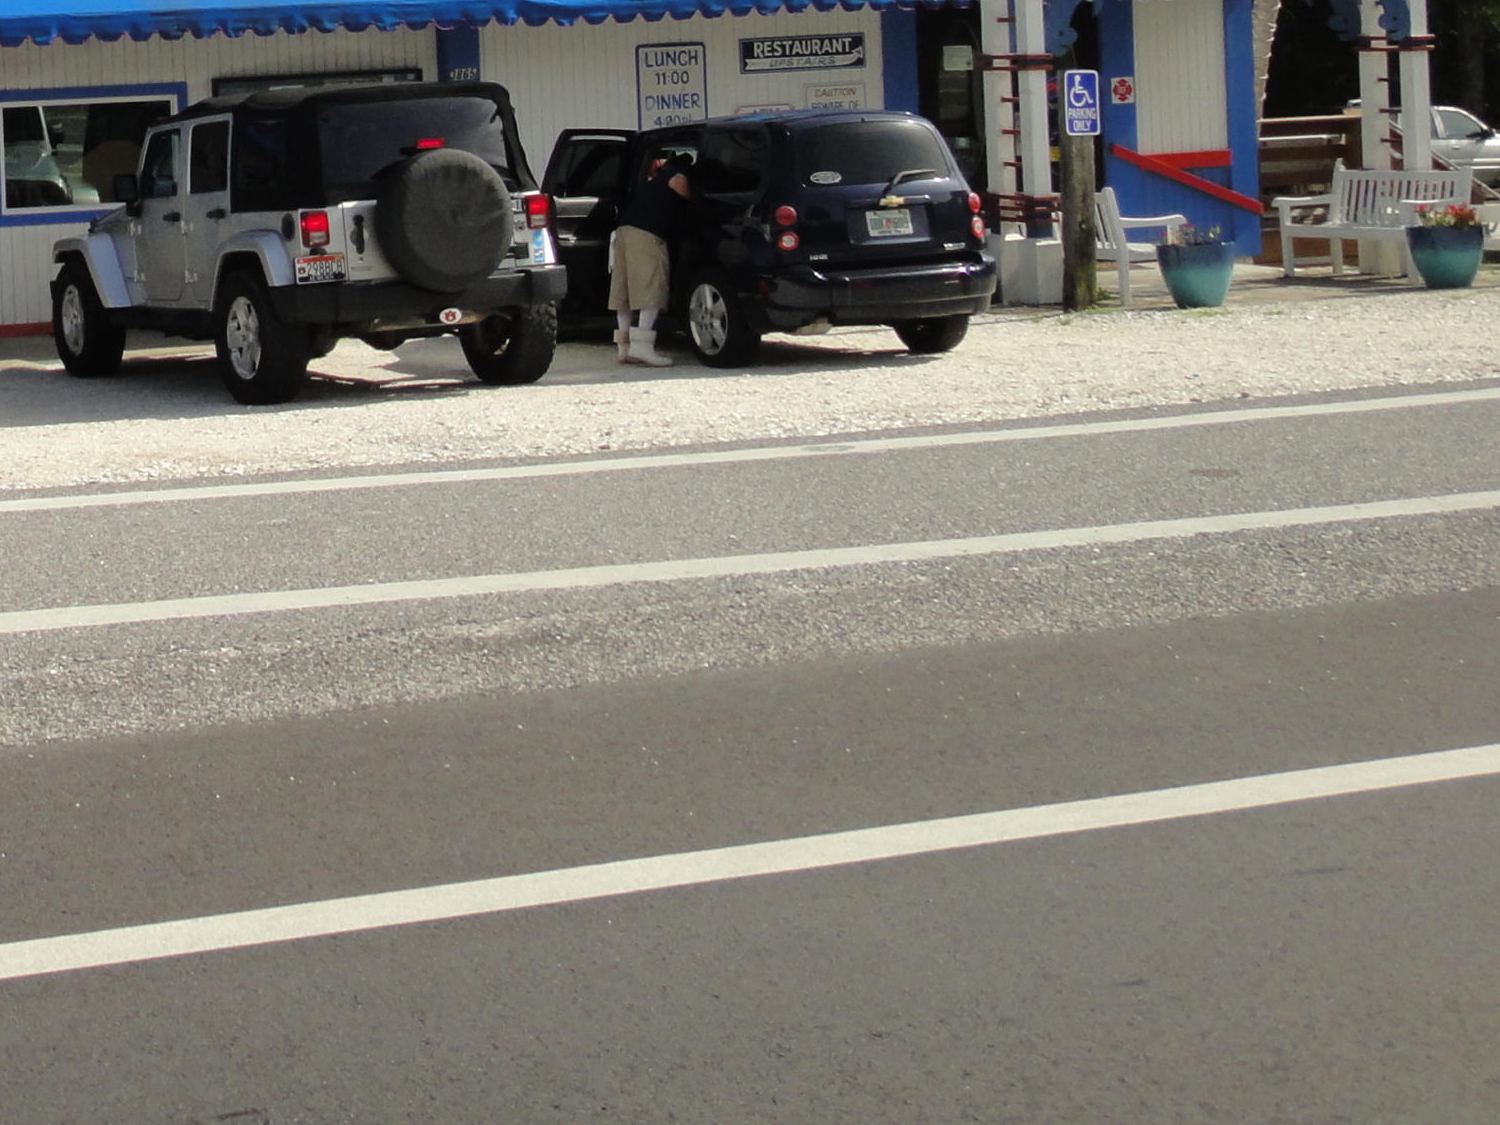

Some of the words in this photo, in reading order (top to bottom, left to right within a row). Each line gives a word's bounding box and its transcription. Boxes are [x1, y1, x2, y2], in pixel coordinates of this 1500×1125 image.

[753, 38, 852, 57] RESTAURANT
[645, 50, 698, 67] LUNCH
[770, 56, 835, 67] UPSTAIRS
[655, 71, 689, 85] 11:00
[814, 88, 856, 97] CAUTION
[645, 93, 701, 110] DINNER
[1068, 108, 1097, 119] PARKING
[1073, 120, 1092, 131] ONLY
